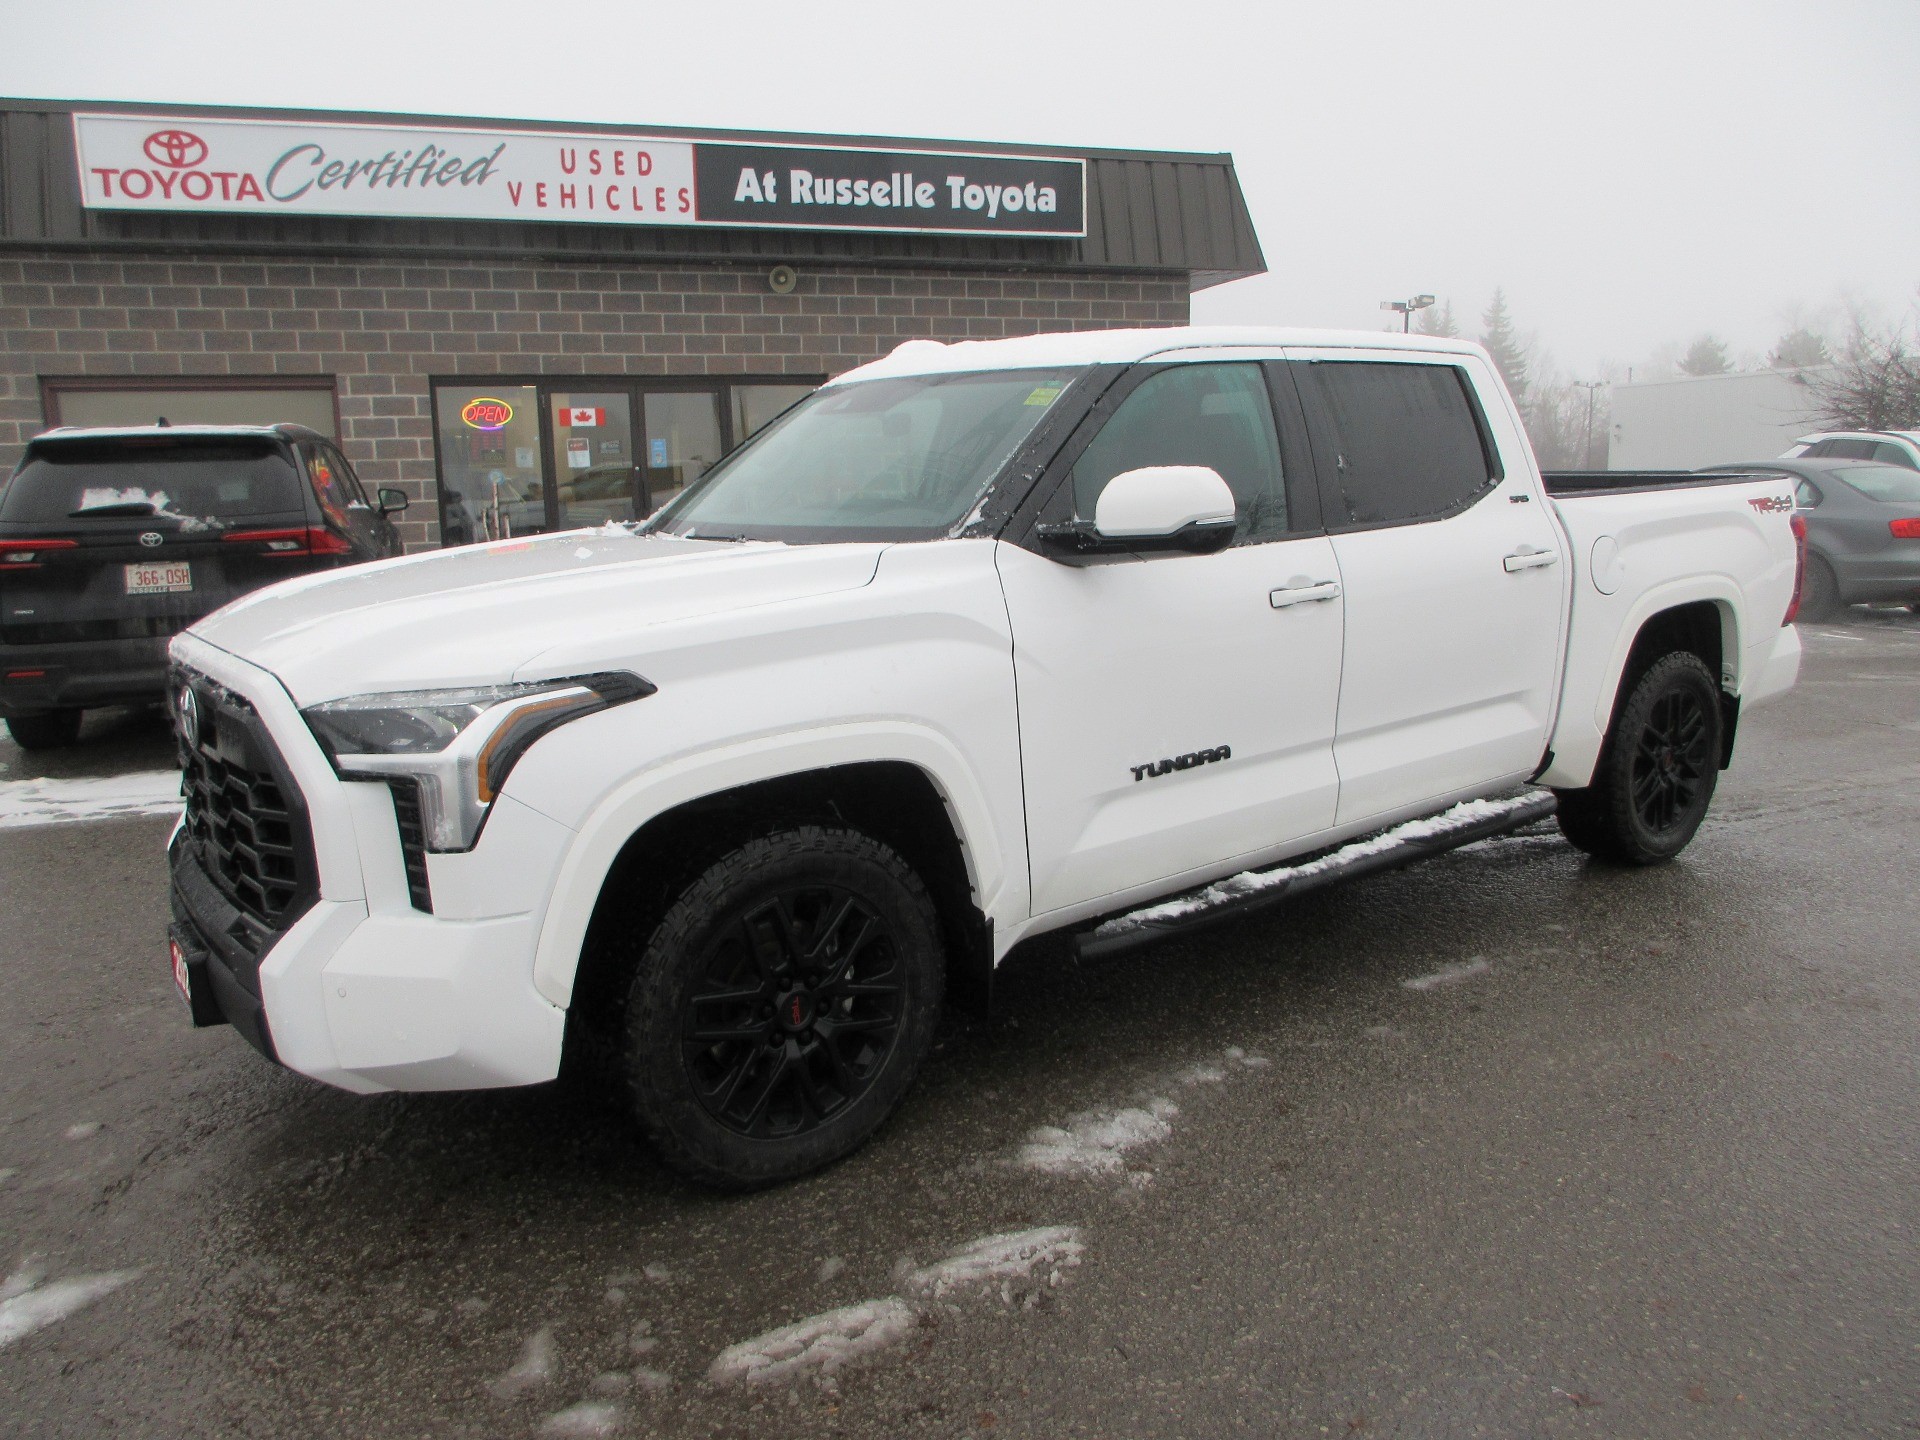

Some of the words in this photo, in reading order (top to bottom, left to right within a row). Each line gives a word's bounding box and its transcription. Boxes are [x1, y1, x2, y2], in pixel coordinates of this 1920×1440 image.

[91, 168, 265, 202] TOYOTA
[266, 142, 507, 202] Certified
[560, 148, 653, 177] USED
[507, 180, 691, 213] VEHICLES
[734, 167, 778, 204] At
[790, 169, 936, 209] Russelle
[946, 175, 1057, 218] Toyota
[465, 405, 508, 422] OPEN
[1129, 744, 1232, 781] TUNDRA
